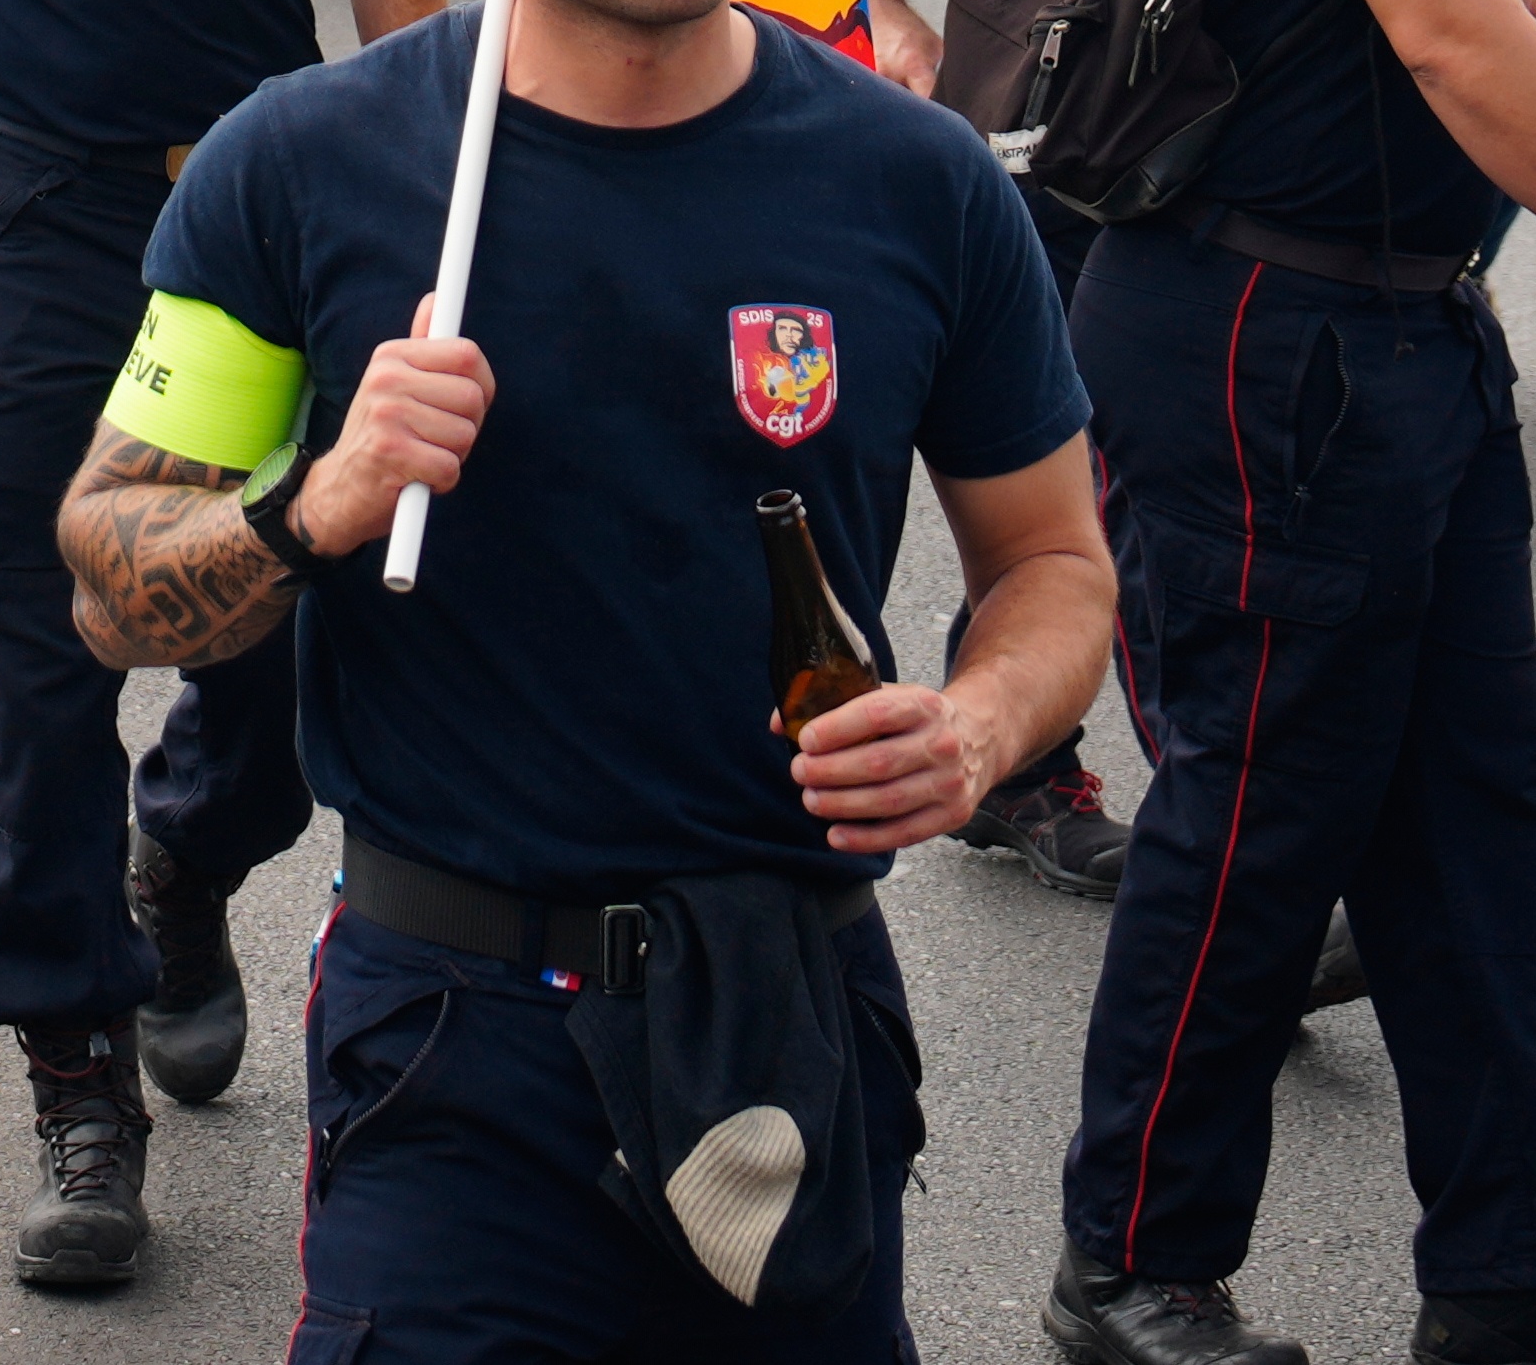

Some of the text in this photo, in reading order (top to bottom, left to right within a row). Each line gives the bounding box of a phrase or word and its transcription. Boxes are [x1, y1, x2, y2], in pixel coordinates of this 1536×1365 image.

[996, 144, 1036, 159] EASTPA
[738, 308, 824, 329] SDIS 25
[765, 411, 805, 438] cgt
